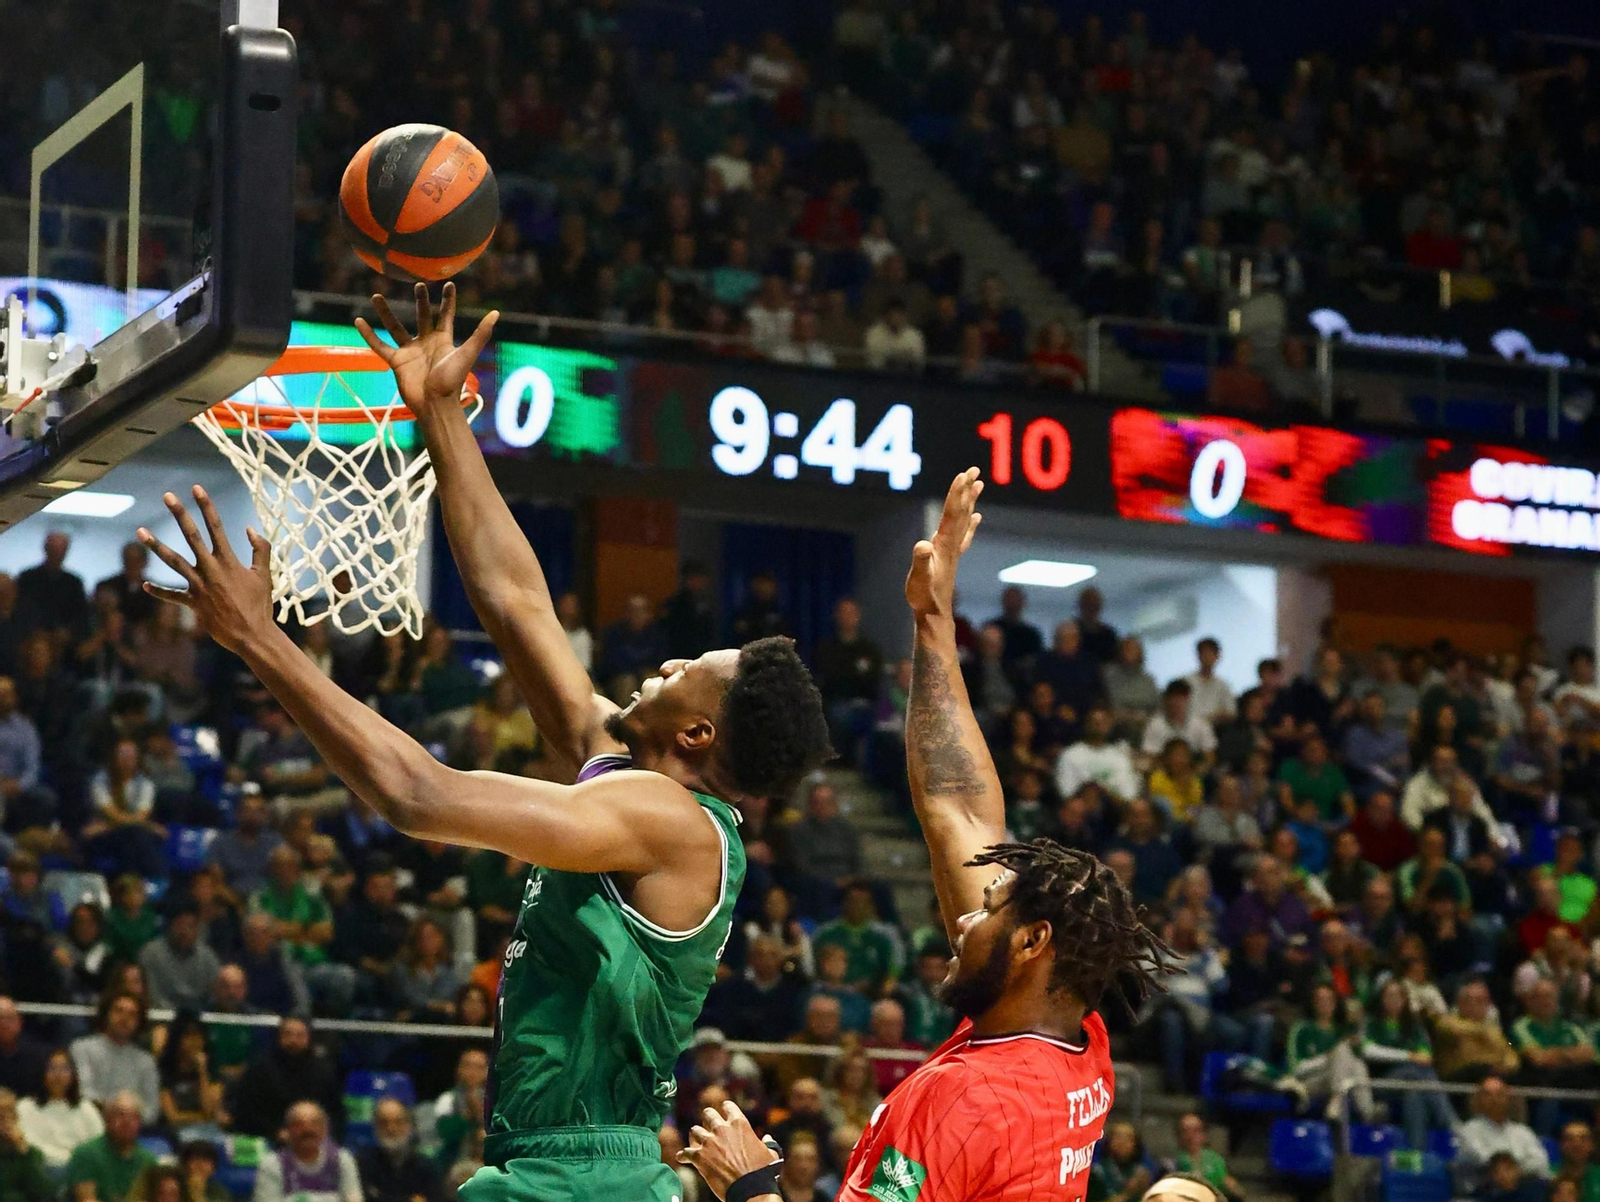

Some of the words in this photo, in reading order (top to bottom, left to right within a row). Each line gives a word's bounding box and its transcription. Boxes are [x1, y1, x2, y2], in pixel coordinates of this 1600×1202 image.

[495, 366, 554, 448] 0
[709, 386, 922, 491] 9:44
[979, 412, 1071, 490] 10
[1190, 440, 1246, 518] 0
